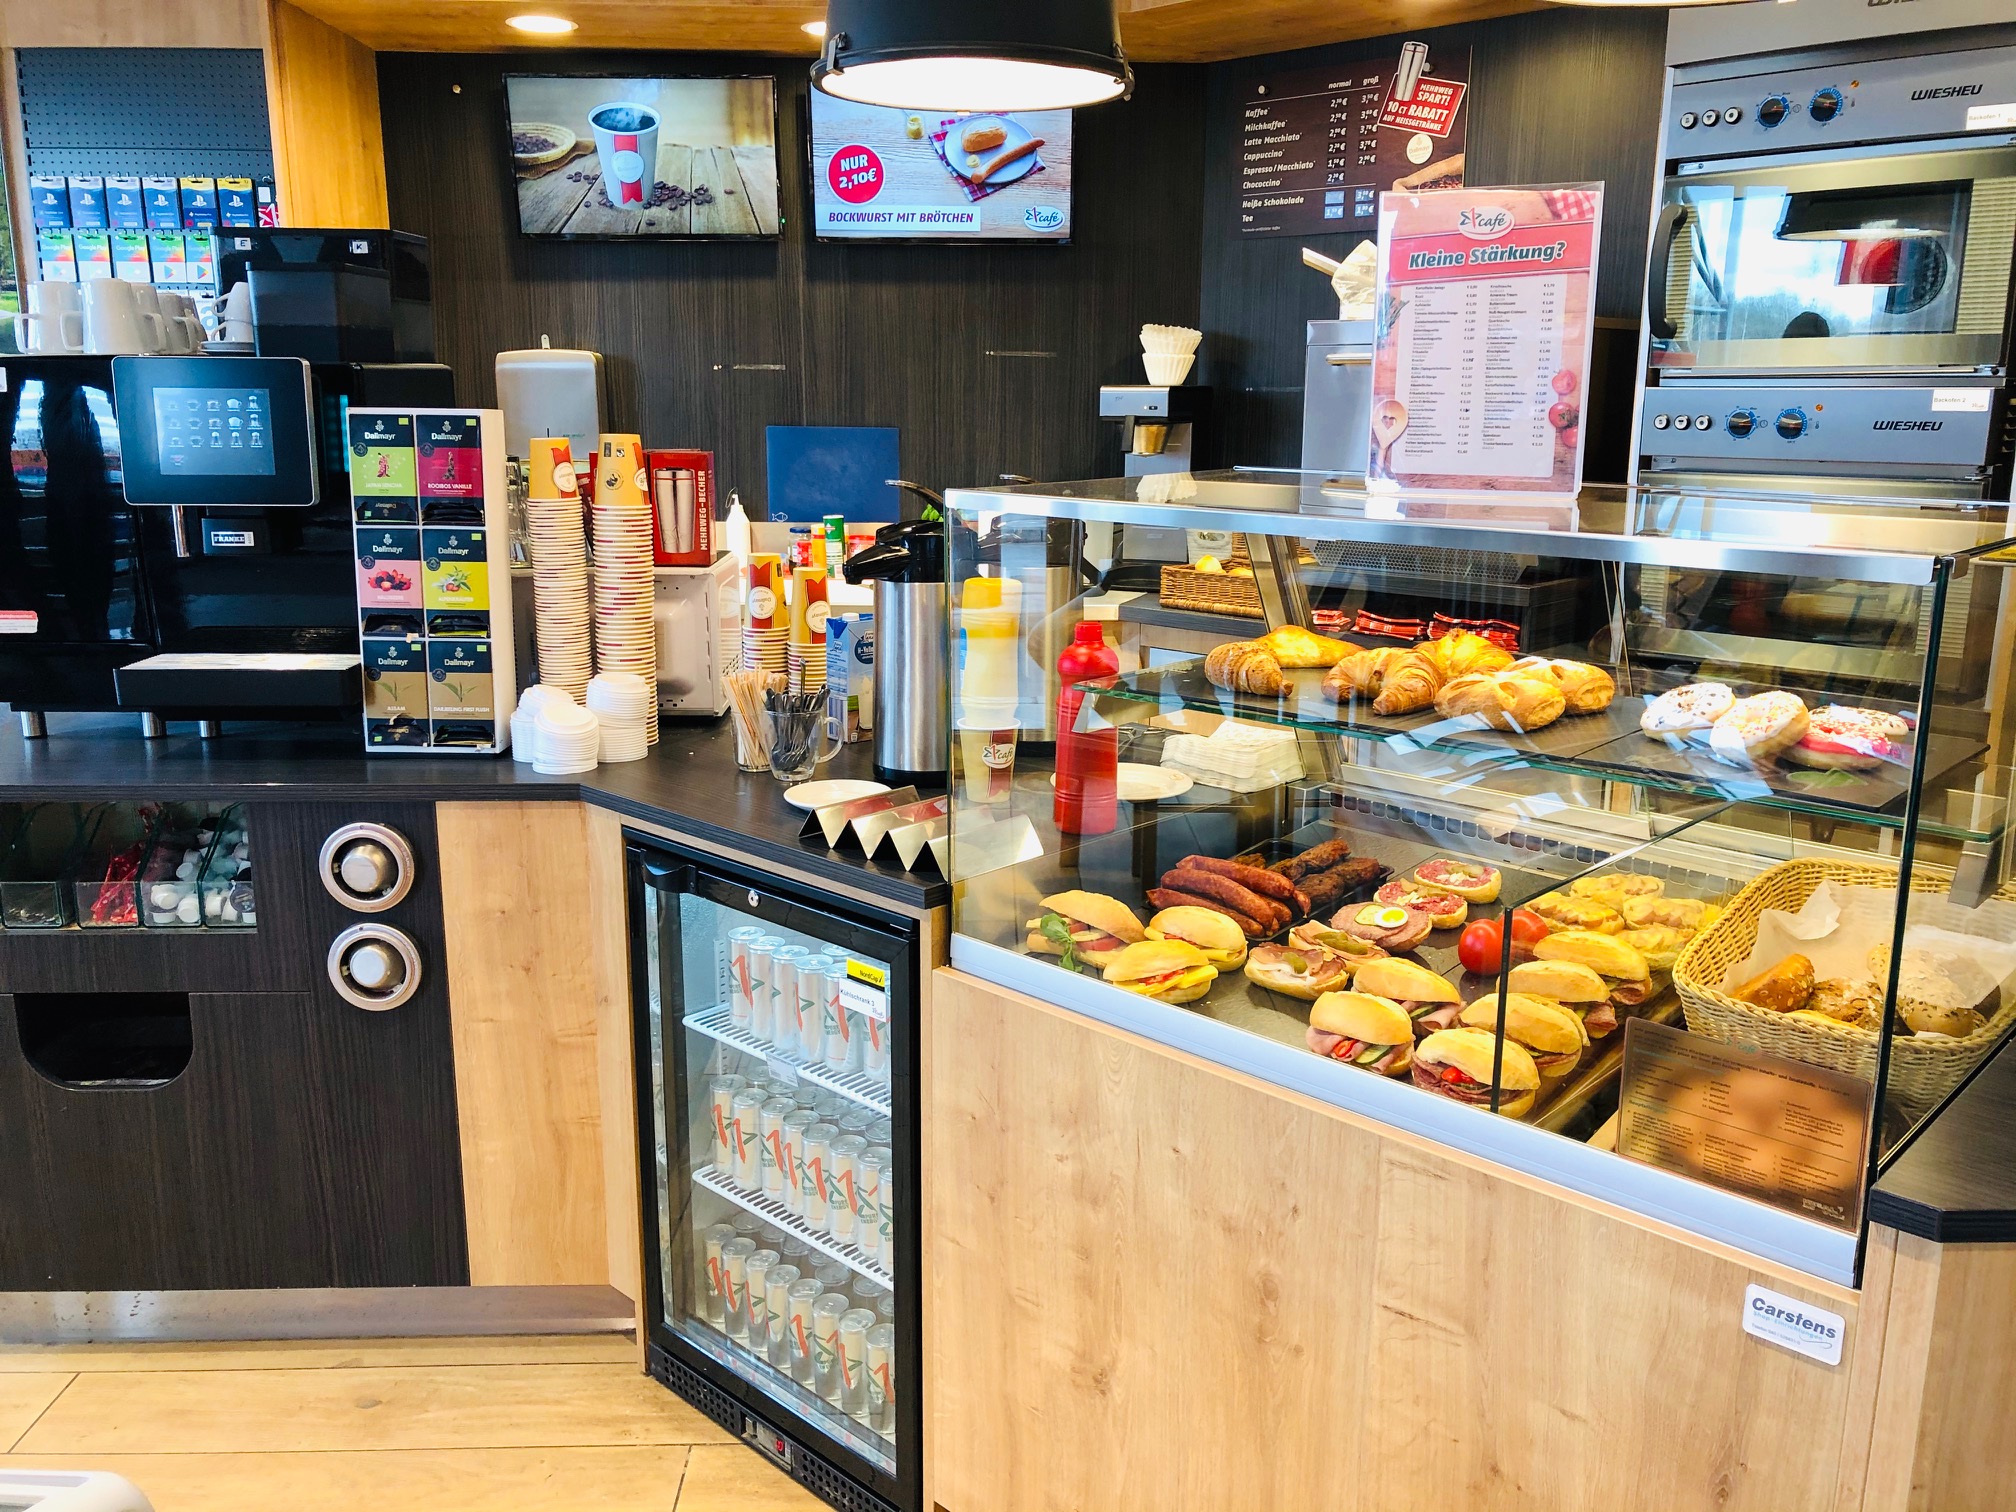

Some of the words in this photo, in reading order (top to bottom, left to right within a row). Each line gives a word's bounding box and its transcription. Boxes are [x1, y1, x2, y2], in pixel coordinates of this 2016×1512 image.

[1328, 79, 1352, 89] normal
[1362, 75, 1379, 86] groß
[1419, 83, 1454, 95] MEHRWEG
[1910, 84, 1984, 101] WIESHEU
[1417, 91, 1451, 106] SPART!
[1382, 113, 1396, 123] AUF
[1387, 101, 1399, 113] 10
[1408, 104, 1450, 122] RABATT
[1244, 137, 1262, 147] Latte
[840, 153, 868, 172] NUR
[838, 167, 877, 190] 2,10€
[1242, 198, 1263, 209] Heiße
[1263, 195, 1305, 207] Schokolade
[828, 211, 893, 223] BOCKWURST
[896, 212, 917, 223] MIT
[918, 210, 974, 224] BRÖTCHEN
[1037, 211, 1060, 227] café
[1242, 214, 1254, 223] Tee
[1477, 213, 1507, 235] café
[240, 239, 248, 247] E
[356, 242, 363, 250] K
[1408, 249, 1465, 270] Kleine
[1469, 241, 1566, 264] Stärkung?
[1872, 420, 1944, 432] WIESHEU
[364, 431, 396, 441] Dallmayr
[431, 432, 463, 442] Dallmayr
[697, 470, 708, 551] MEHRWEG-BECHER
[213, 535, 246, 543] FRANKE
[372, 545, 404, 554] Dallmayr
[438, 547, 469, 556] Dallmayr
[377, 657, 409, 667] Dallmayr
[444, 658, 475, 667] Dallmayr
[859, 970, 879, 983] NordCap
[840, 989, 871, 1005] Kühlschrank
[1752, 1297, 1837, 1339] Carstens
